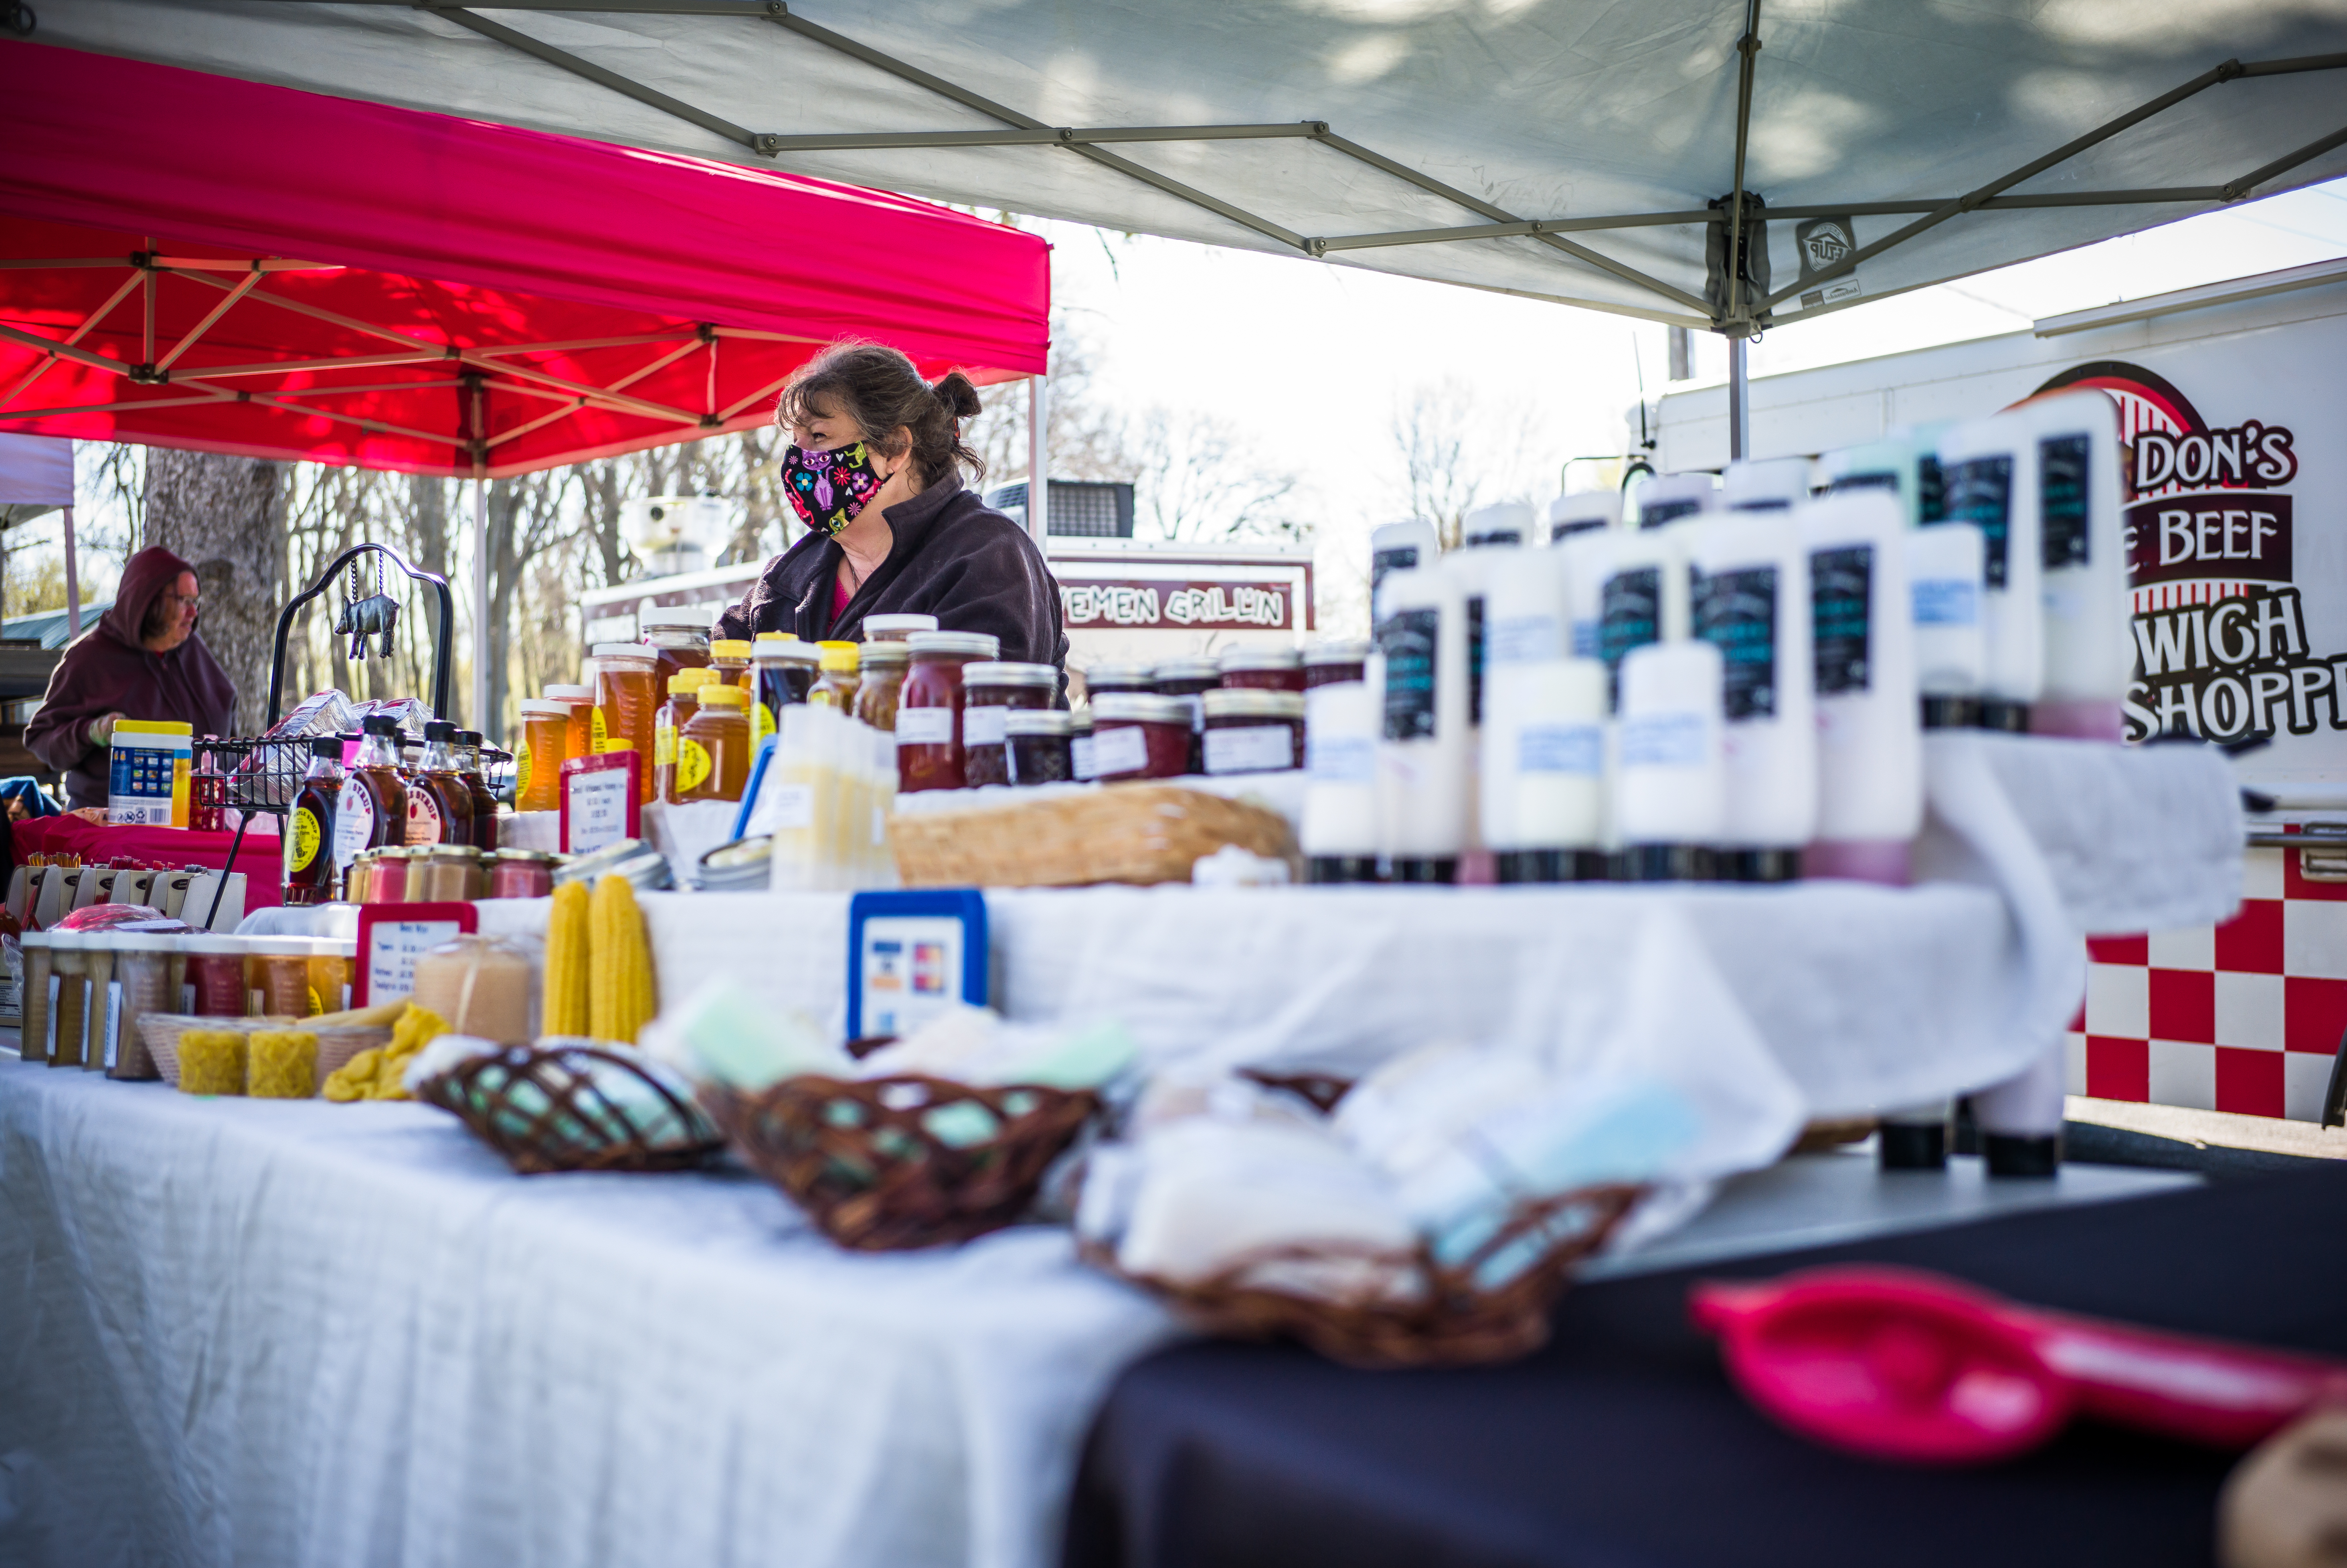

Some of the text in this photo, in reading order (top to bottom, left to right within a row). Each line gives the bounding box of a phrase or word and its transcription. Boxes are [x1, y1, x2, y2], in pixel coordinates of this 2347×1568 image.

[2137, 426, 2292, 488] DON'S
[2159, 510, 2278, 566] BEEF
[353, 783, 370, 815] SYRUP
[416, 791, 437, 820] SYRUP
